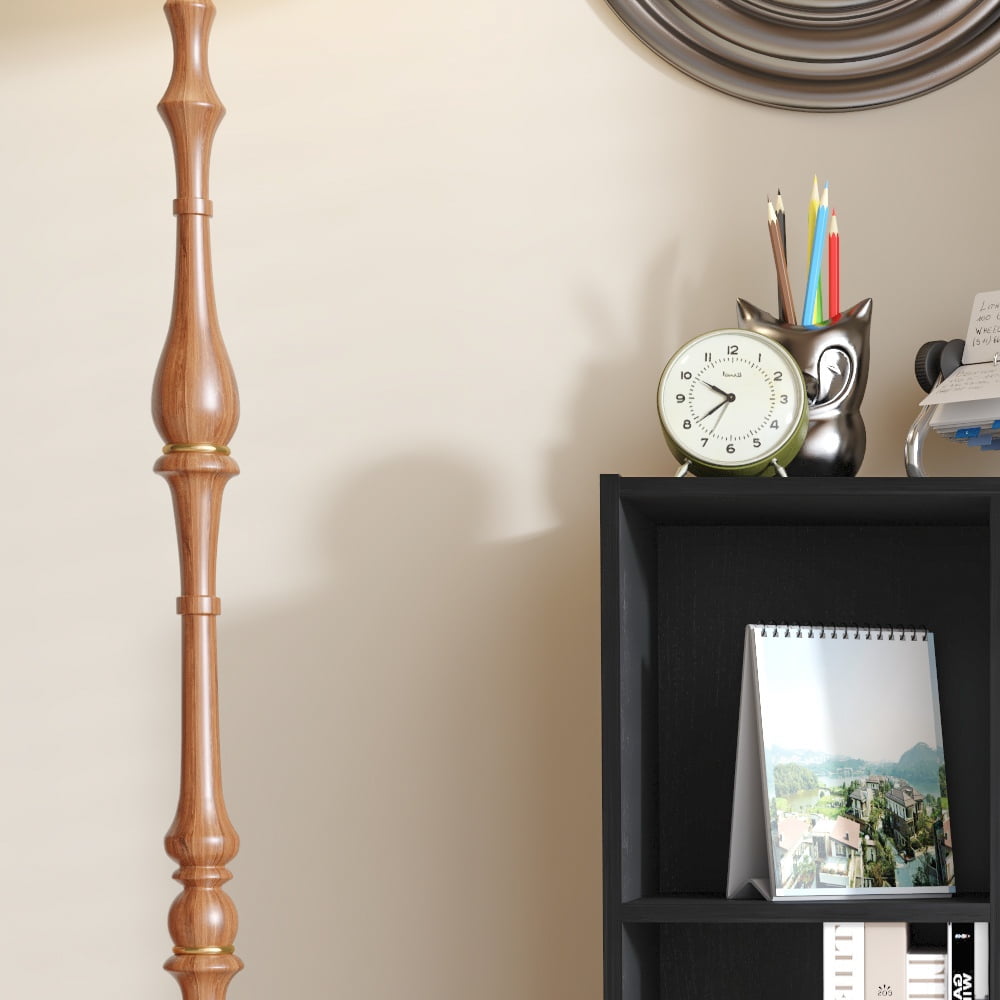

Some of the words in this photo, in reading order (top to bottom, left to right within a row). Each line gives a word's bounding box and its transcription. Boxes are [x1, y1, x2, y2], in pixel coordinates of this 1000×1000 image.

[727, 345, 739, 355] 12
[704, 352, 712, 362] 11
[680, 371, 692, 380] 10
[773, 371, 783, 381] 2
[676, 394, 685, 404] 9
[780, 395, 788, 404] 3
[683, 420, 692, 429] 8
[770, 420, 779, 430] 4
[700, 438, 709, 448] 7
[753, 438, 762, 448] 5
[726, 444, 735, 453] 6
